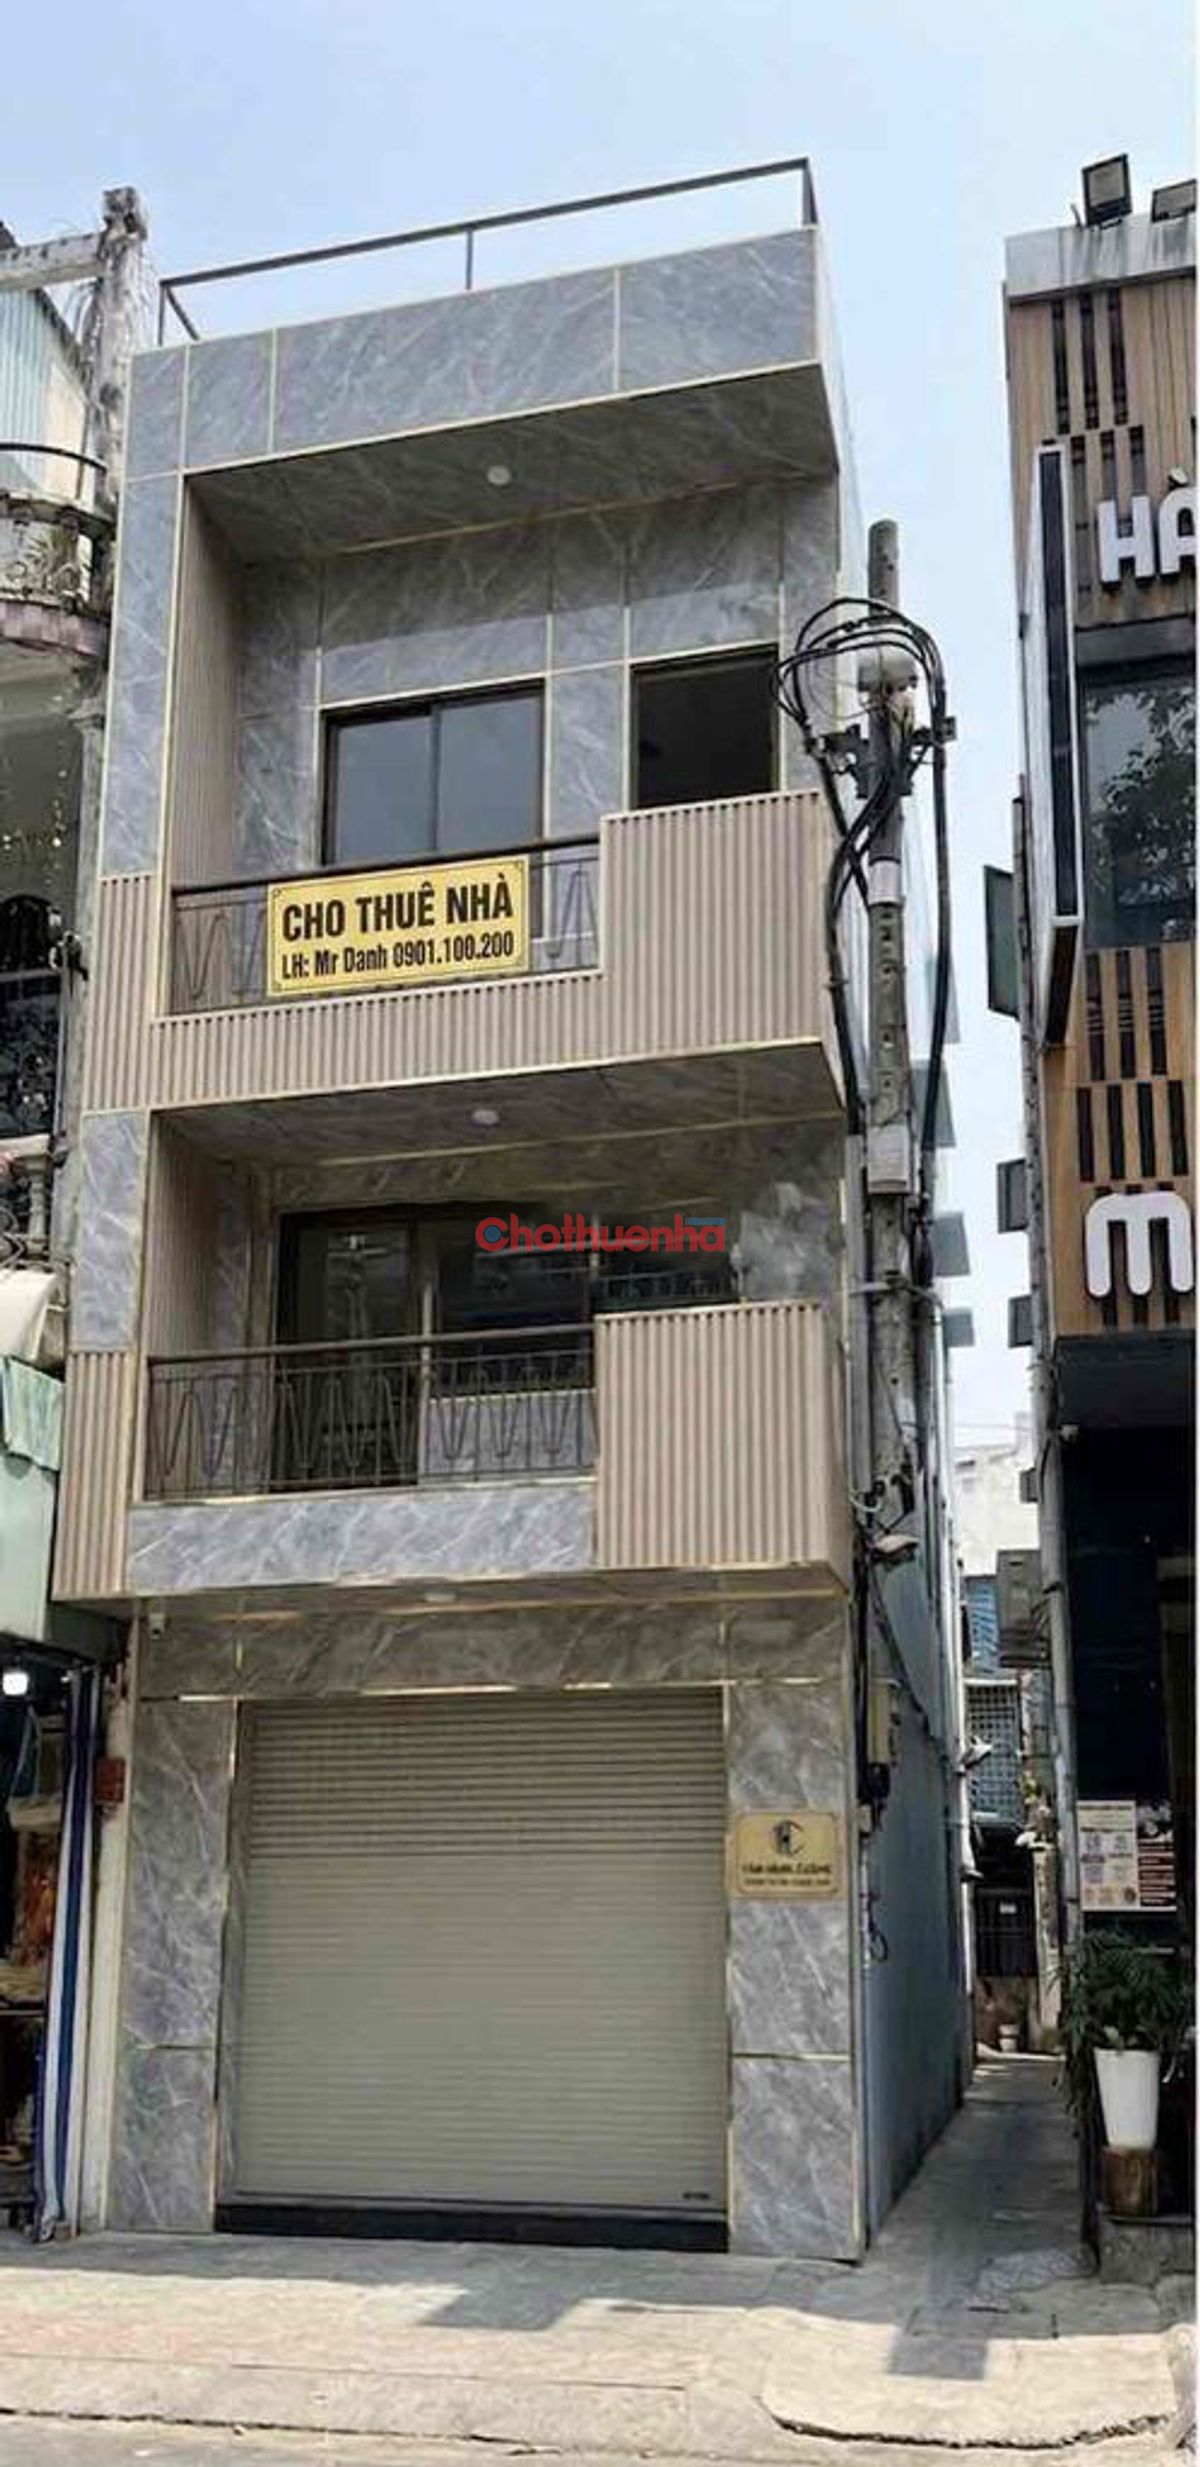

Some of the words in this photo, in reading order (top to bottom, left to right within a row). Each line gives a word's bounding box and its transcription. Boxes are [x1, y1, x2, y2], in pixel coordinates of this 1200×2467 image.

[282, 899, 346, 942] CHO
[355, 881, 435, 934] THUÊ
[446, 872, 513, 924] NHÀ
[282, 953, 310, 980] LH:
[314, 950, 339, 977] Mr
[343, 943, 388, 974] Danh
[392, 930, 514, 968] 0901.100.200
